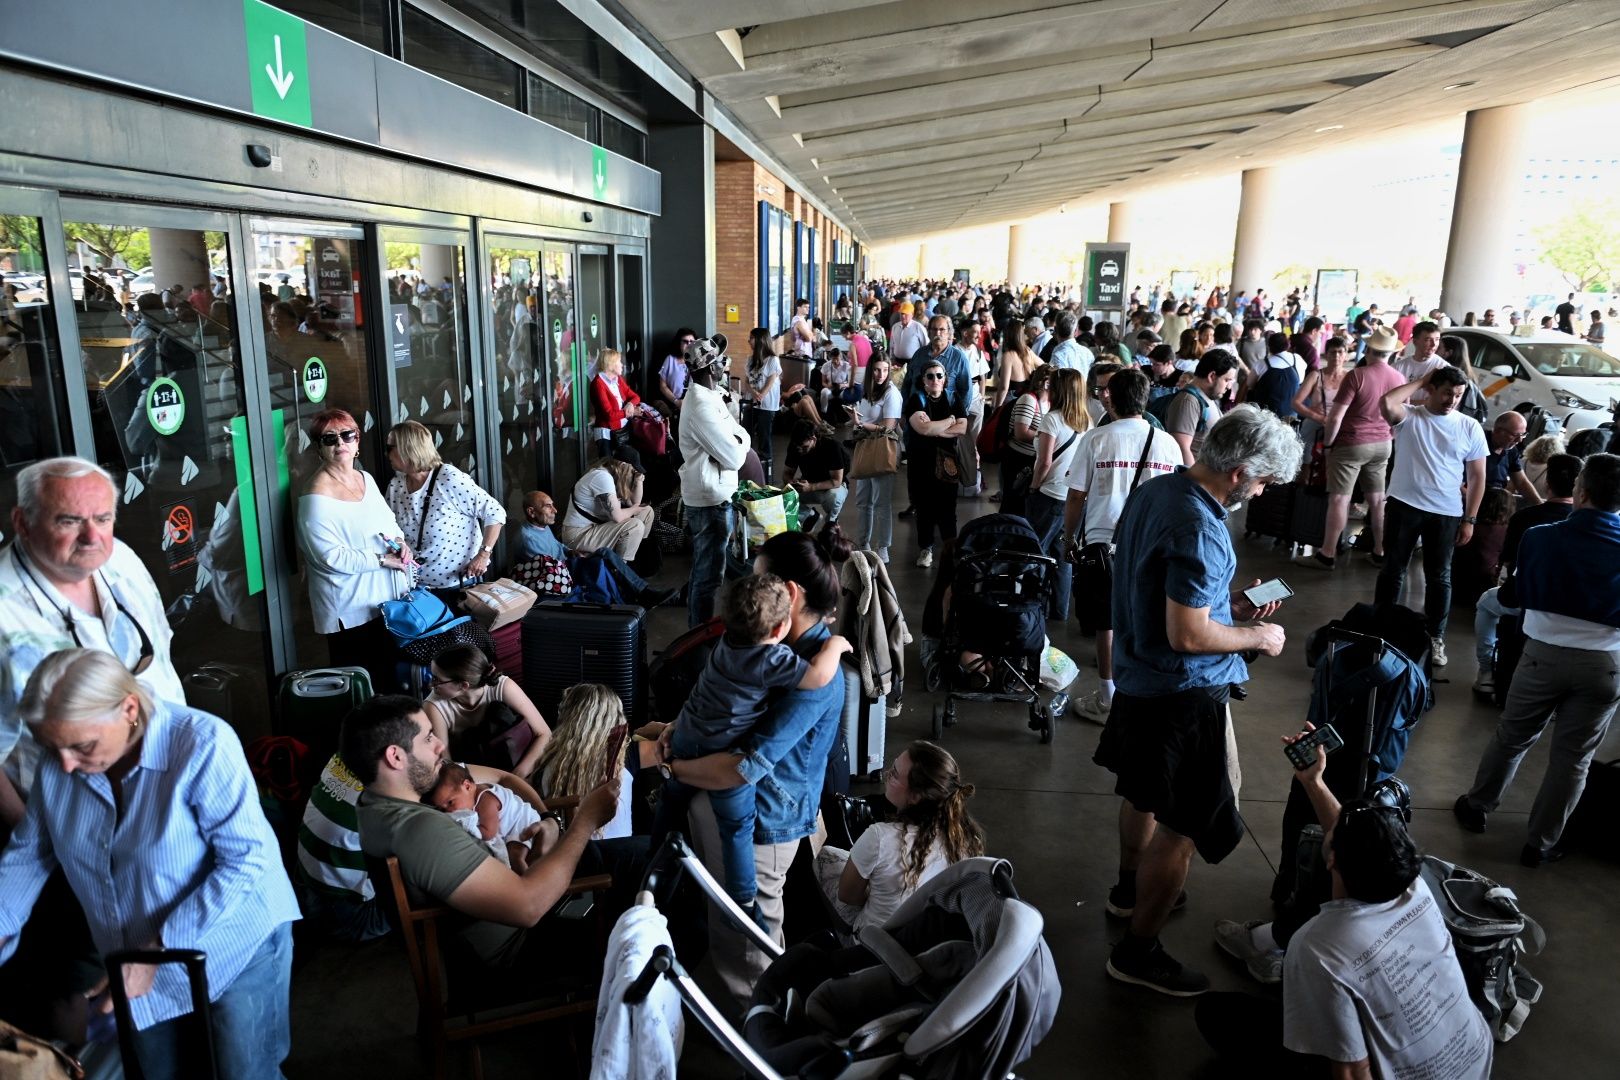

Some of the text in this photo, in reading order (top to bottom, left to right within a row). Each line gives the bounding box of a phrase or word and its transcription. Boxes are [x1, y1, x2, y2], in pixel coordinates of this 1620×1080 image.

[1100, 282, 1120, 293] Taxi
[1096, 460, 1174, 472] EASTERN COFERENCE
